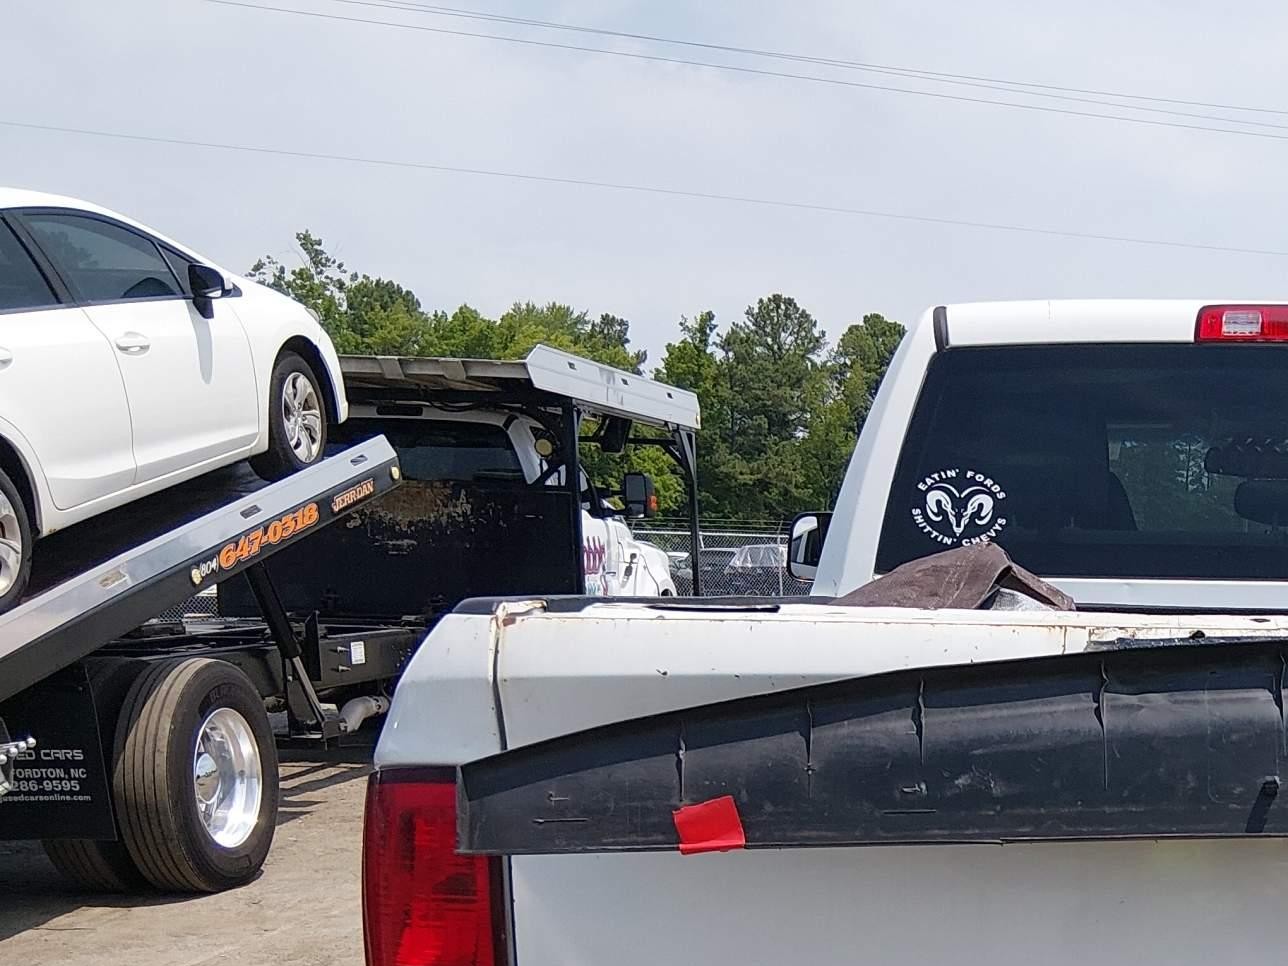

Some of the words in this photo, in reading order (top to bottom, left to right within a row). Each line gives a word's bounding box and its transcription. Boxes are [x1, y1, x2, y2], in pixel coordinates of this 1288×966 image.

[917, 468, 960, 491] EATIN'
[966, 470, 1006, 499] FORDS
[200, 555, 218, 577] (804)
[219, 502, 320, 570] 647-0318
[911, 508, 957, 545] SHITTIN'
[962, 517, 1007, 546] CHEVYS
[40, 749, 84, 760] CARS
[70, 768, 87, 778] NC
